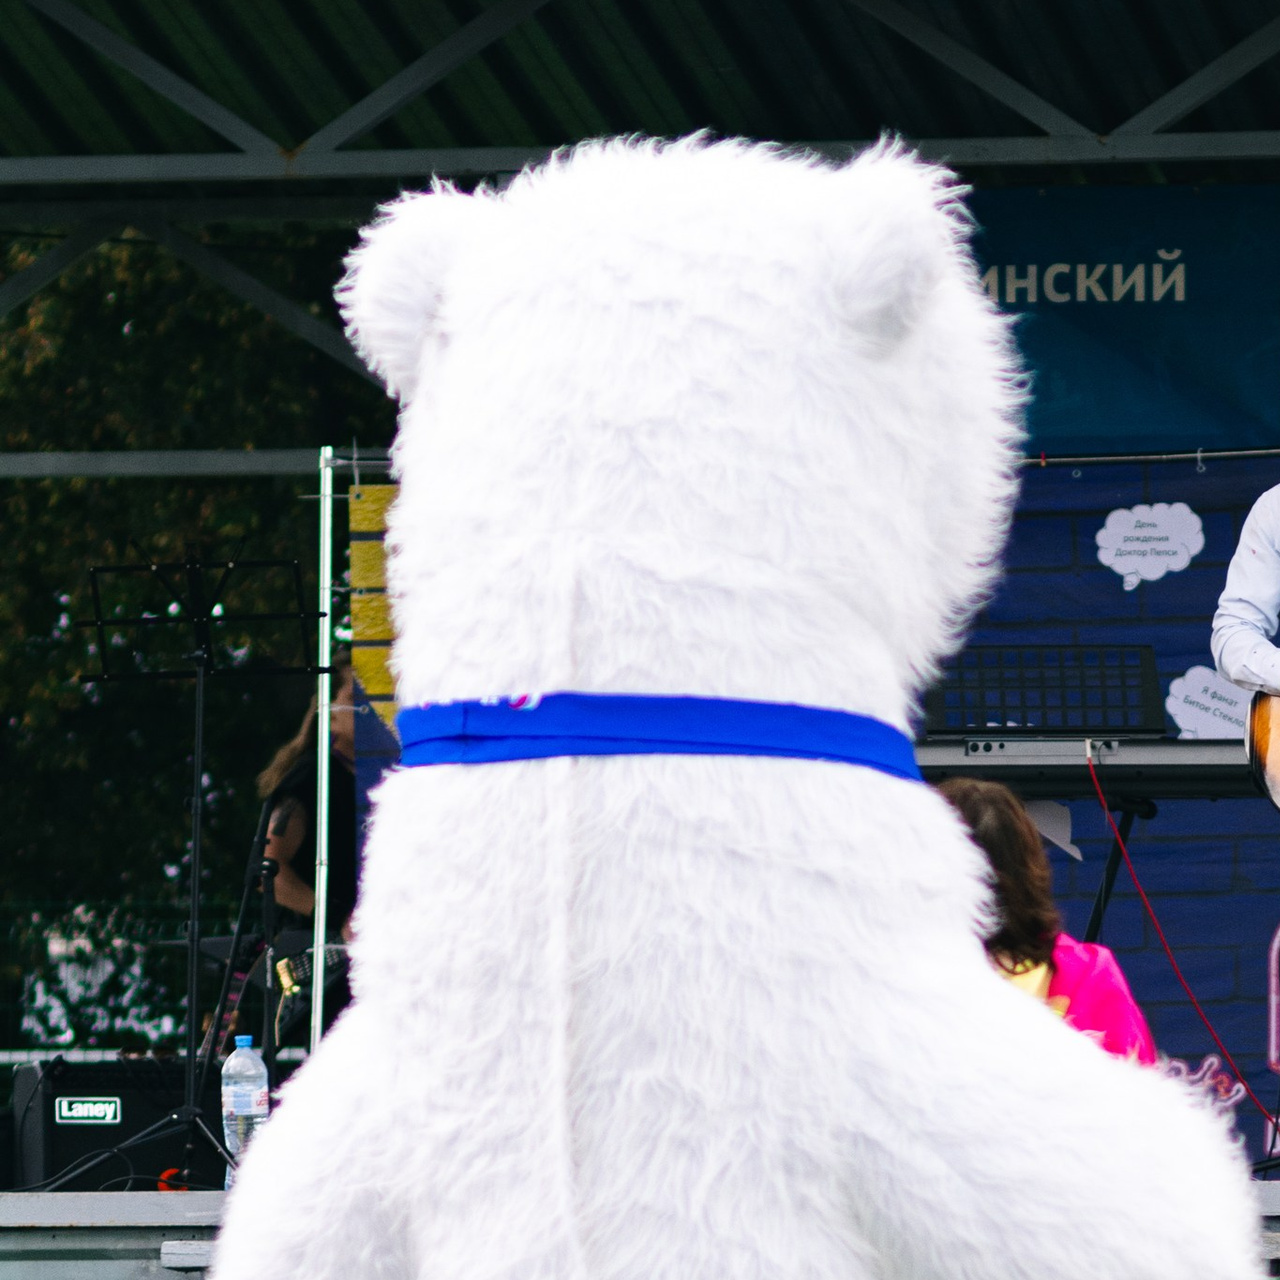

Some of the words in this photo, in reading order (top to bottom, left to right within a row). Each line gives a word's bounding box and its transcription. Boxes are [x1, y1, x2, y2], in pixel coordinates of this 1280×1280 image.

[1134, 520, 1158, 529] День
[1123, 535, 1169, 543] рождения
[1115, 548, 1147, 557] Доктор
[1150, 548, 1178, 557] Пепси
[1201, 686, 1210, 695] Я
[1210, 691, 1239, 708] фанат
[1183, 695, 1211, 713] Битое
[1212, 708, 1245, 728] Стекло
[61, 1100, 115, 1121] Laney
